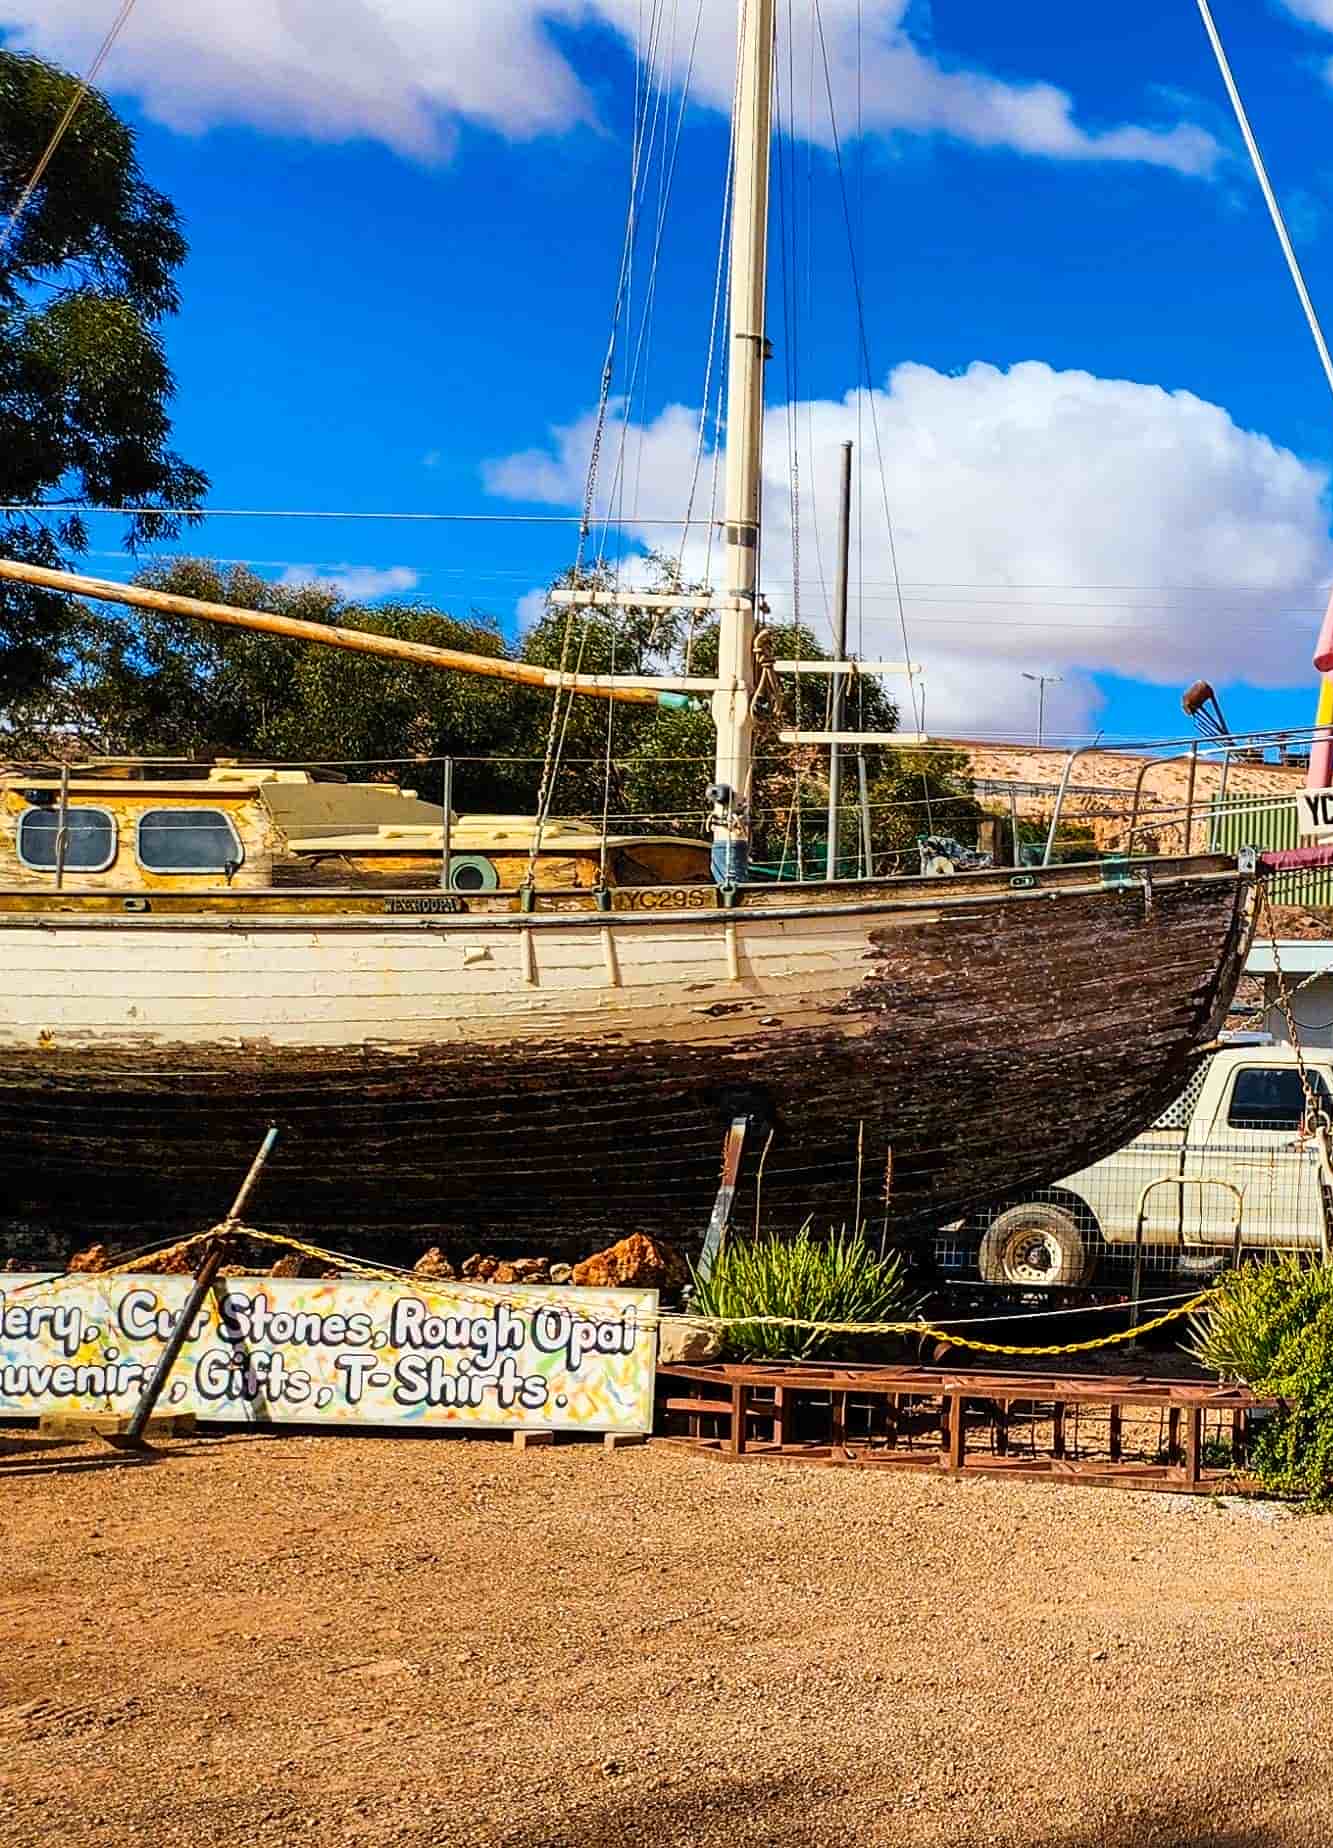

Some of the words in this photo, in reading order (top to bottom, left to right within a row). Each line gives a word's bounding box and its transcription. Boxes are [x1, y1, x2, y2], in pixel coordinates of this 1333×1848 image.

[0, 1289, 99, 1357] ery,
[217, 1292, 388, 1350] Stones,
[389, 1297, 525, 1371] Rough
[531, 1304, 638, 1371] Opal
[0, 1347, 188, 1405] uvenir,
[195, 1349, 334, 1408] Gifts,
